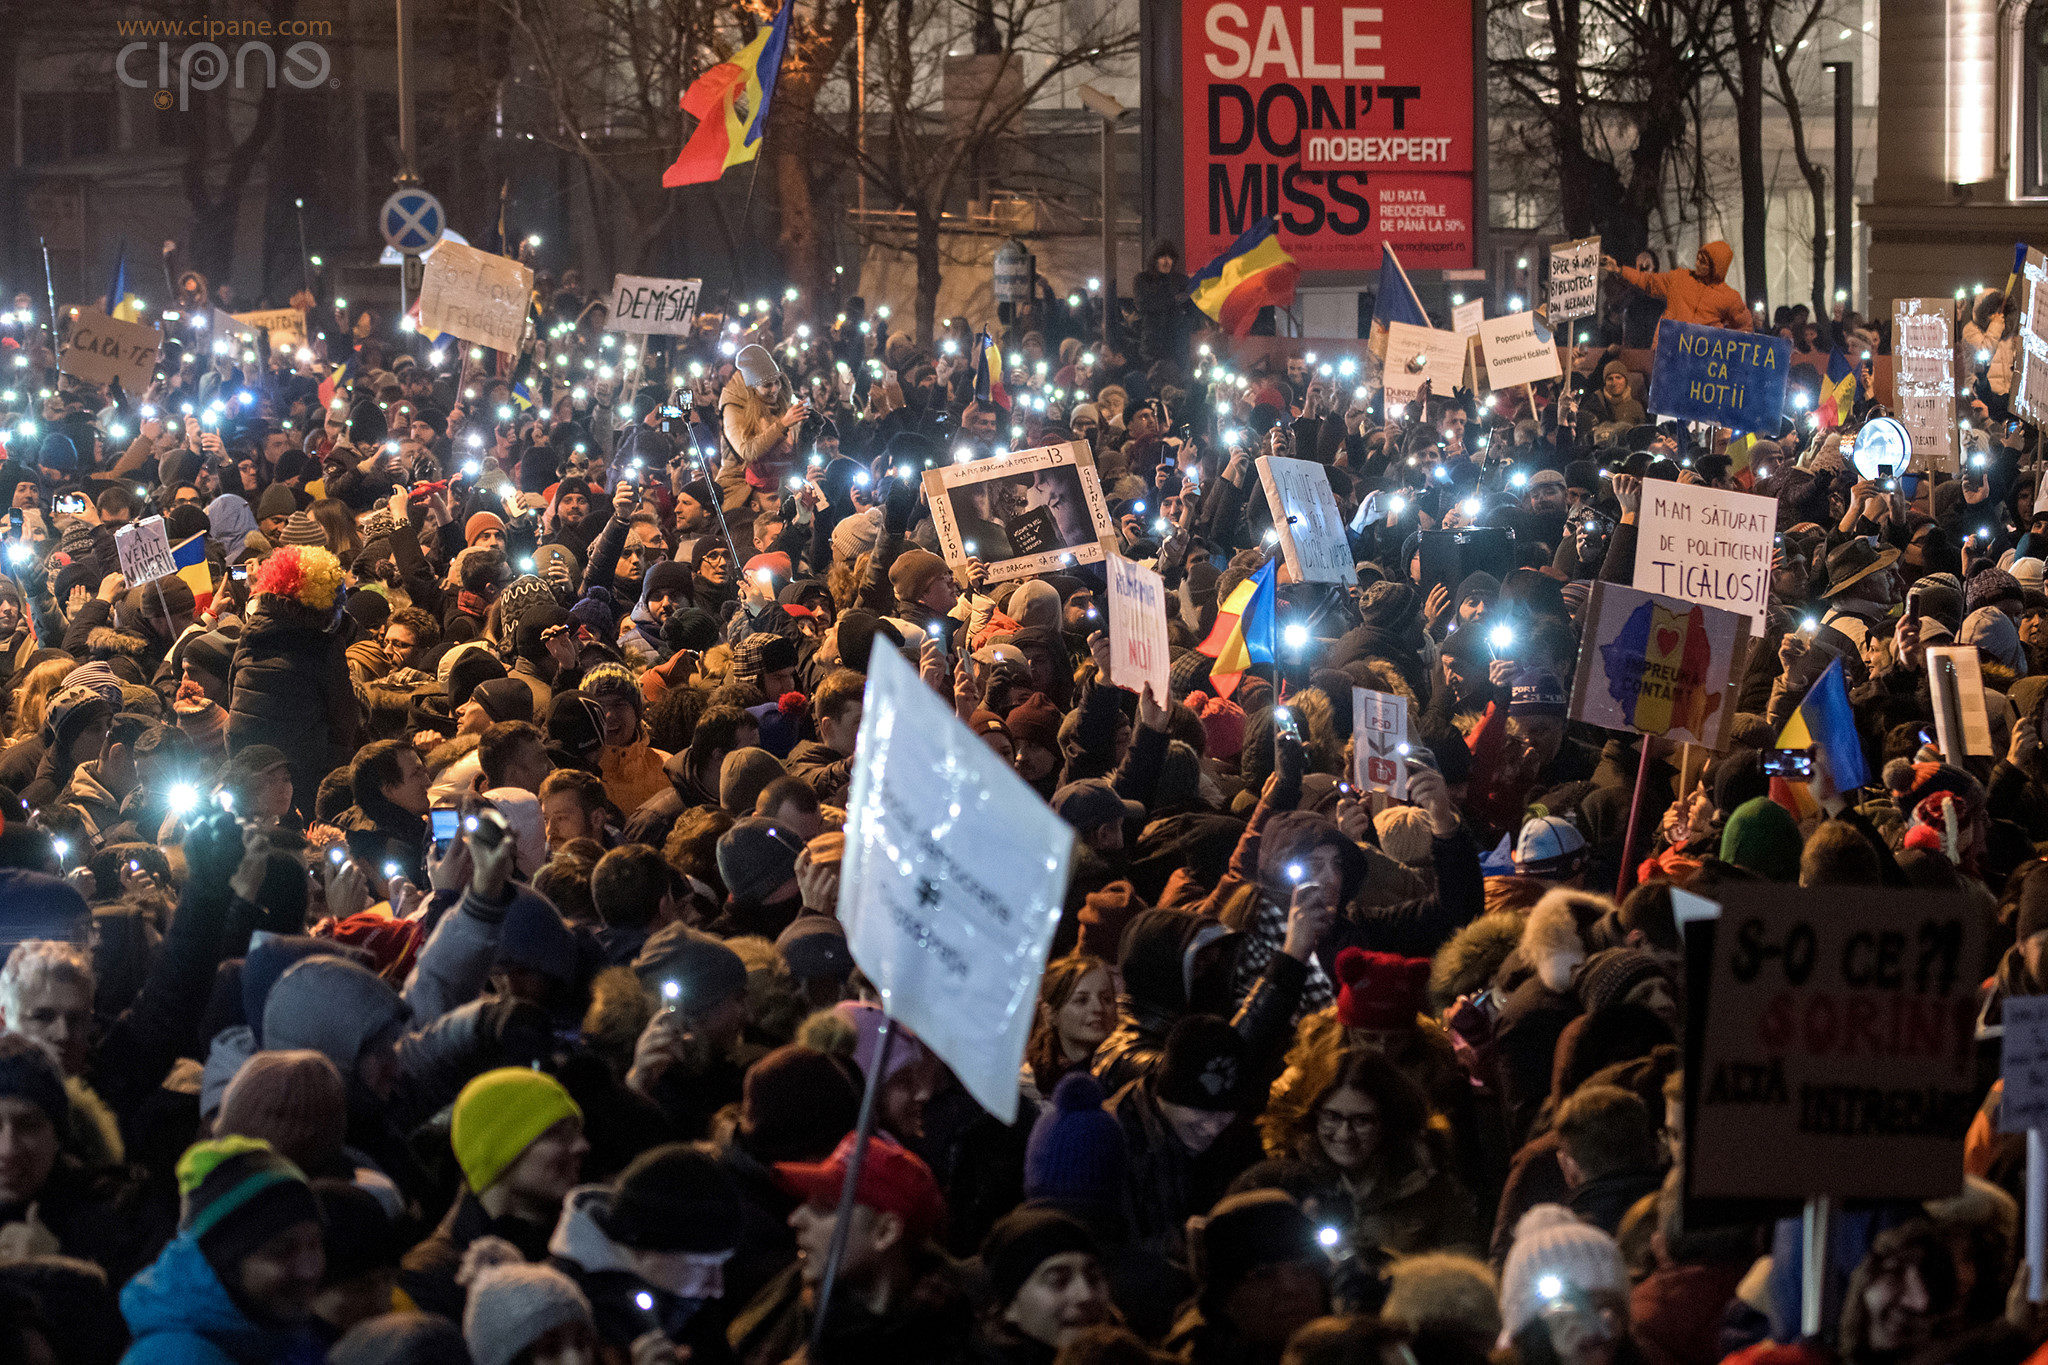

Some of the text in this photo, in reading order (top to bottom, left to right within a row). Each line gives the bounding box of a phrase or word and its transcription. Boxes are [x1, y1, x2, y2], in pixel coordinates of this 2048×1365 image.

[1204, 3, 1385, 79] SALE
[1308, 137, 1452, 162] MOBEXPERT
[1208, 163, 1371, 236] MISS
[1380, 190, 1426, 202] NU RATA
[1380, 204, 1446, 217] REDUCERILE
[1380, 219, 1394, 231] DE
[1428, 219, 1442, 231] LA
[1445, 219, 1465, 231] 50%
[616, 285, 698, 322] DEMISIA
[1678, 333, 1776, 370] NOAPTEA
[1707, 361, 1728, 380] CA
[1047, 447, 1063, 465] 13
[1083, 468, 1106, 529] GHINION
[936, 497, 959, 560] GHINION
[1701, 505, 1768, 533] SĂTURAT
[124, 538, 163, 565] VENIT
[1088, 547, 1097, 558] 13
[1660, 534, 1770, 564] DE POLITICIENI
[1128, 638, 1152, 671] NOI
[1371, 716, 1391, 730] PSD
[1731, 917, 1816, 986] S-O
